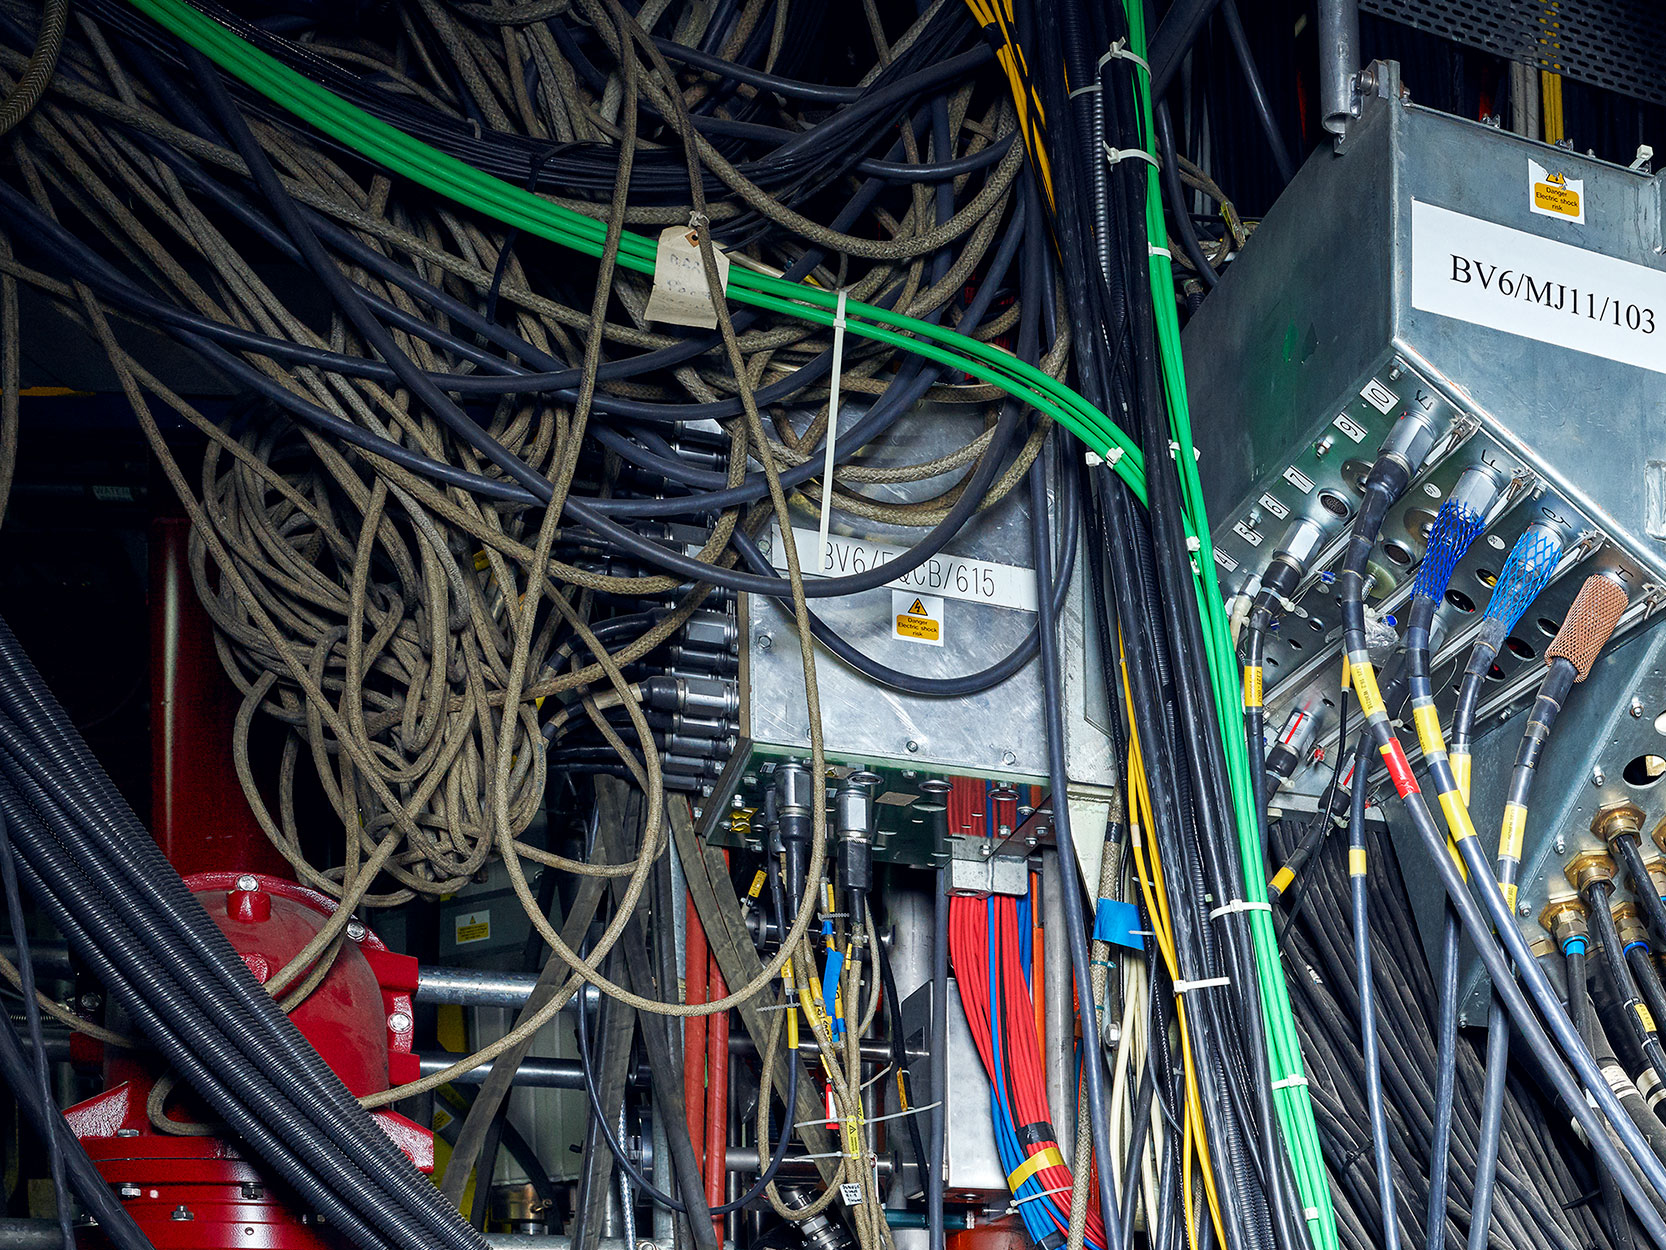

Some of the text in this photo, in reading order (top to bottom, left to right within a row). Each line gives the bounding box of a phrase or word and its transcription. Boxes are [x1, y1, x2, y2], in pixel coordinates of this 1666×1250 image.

[1546, 187, 1567, 197] Danger
[1536, 192, 1578, 207] Electric shock
[1450, 253, 1656, 335] BV6/MJ11/103
[1239, 526, 1257, 541] 5
[898, 622, 938, 633] Electric shock
[907, 617, 928, 627] Danger
